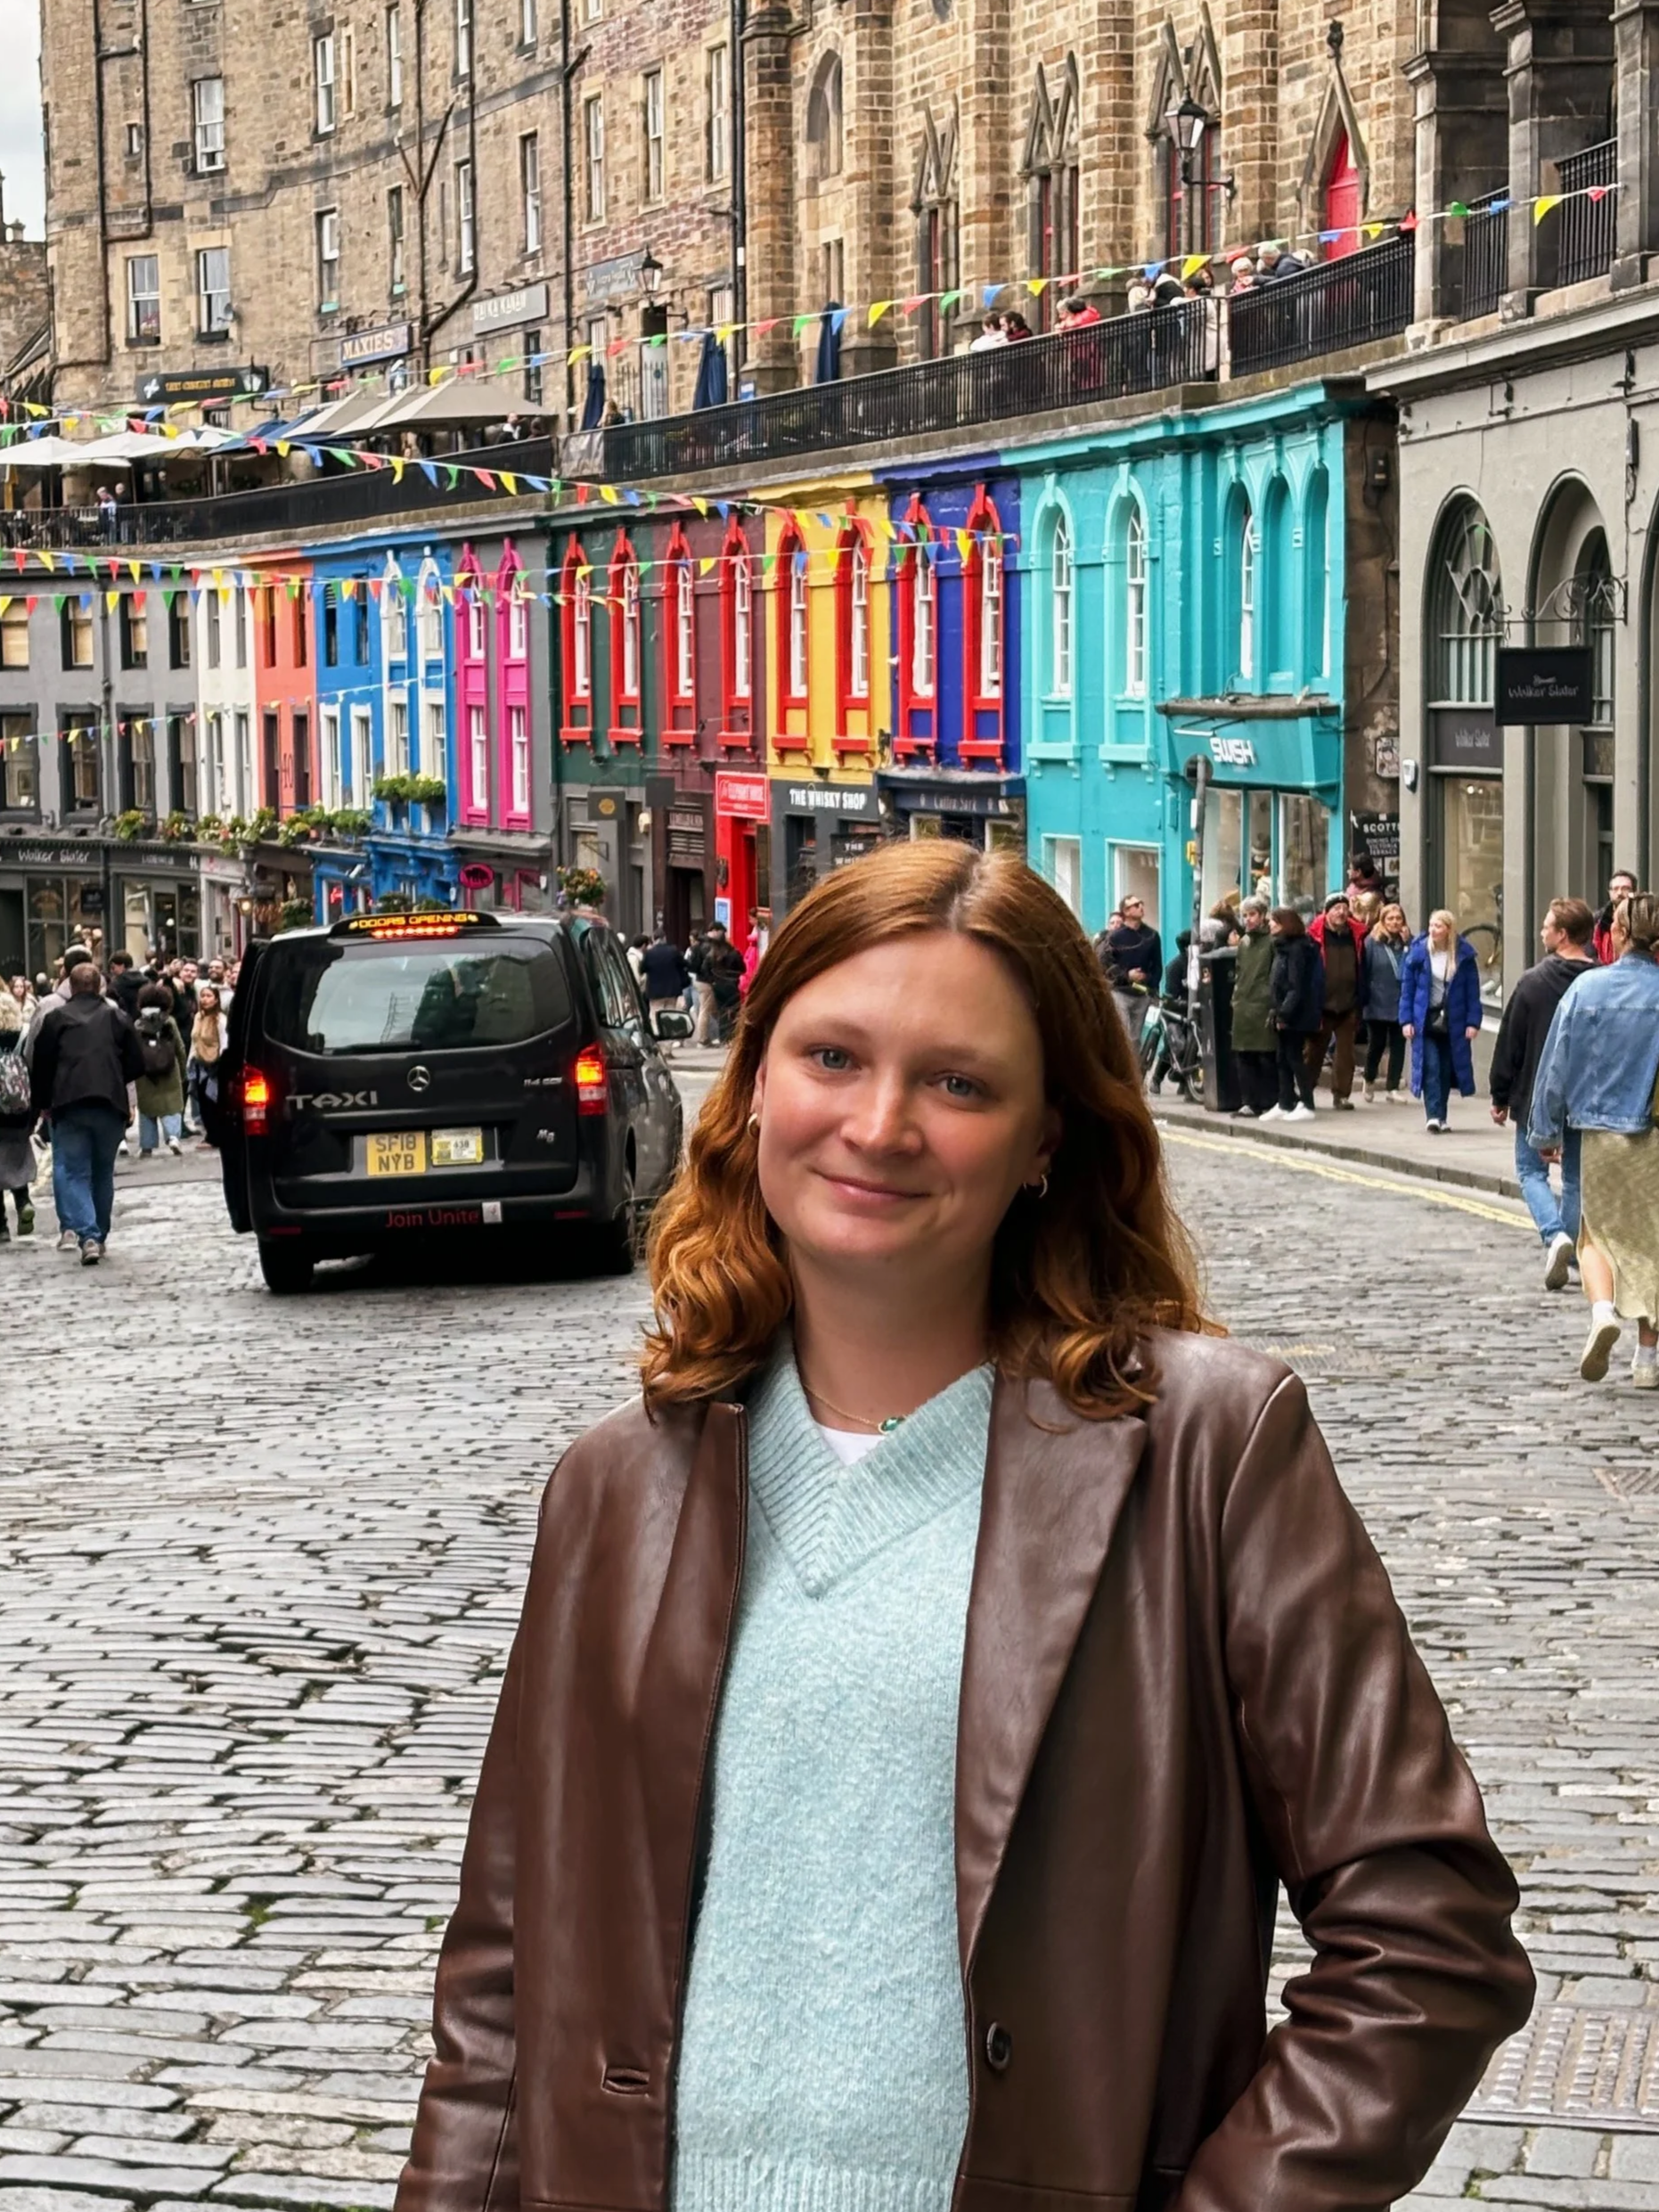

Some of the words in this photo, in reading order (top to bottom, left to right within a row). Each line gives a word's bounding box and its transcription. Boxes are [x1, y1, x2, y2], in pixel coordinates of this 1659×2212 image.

[342, 330, 394, 360] MAXIES
[1508, 683, 1545, 698] Walker
[1548, 684, 1579, 698] Slater
[1210, 737, 1255, 765] SWISH
[789, 789, 806, 807] THE
[807, 790, 840, 809] WHISKY
[842, 791, 866, 810] SHOP
[18, 848, 54, 862] Walker
[359, 916, 405, 929] DOORS
[408, 913, 468, 924] OPENING
[285, 1090, 378, 1110] TAXI
[376, 1133, 417, 1153] SF18
[378, 1153, 415, 1172] NYB
[385, 1209, 423, 1228] Join
[429, 1207, 479, 1225] Unite
